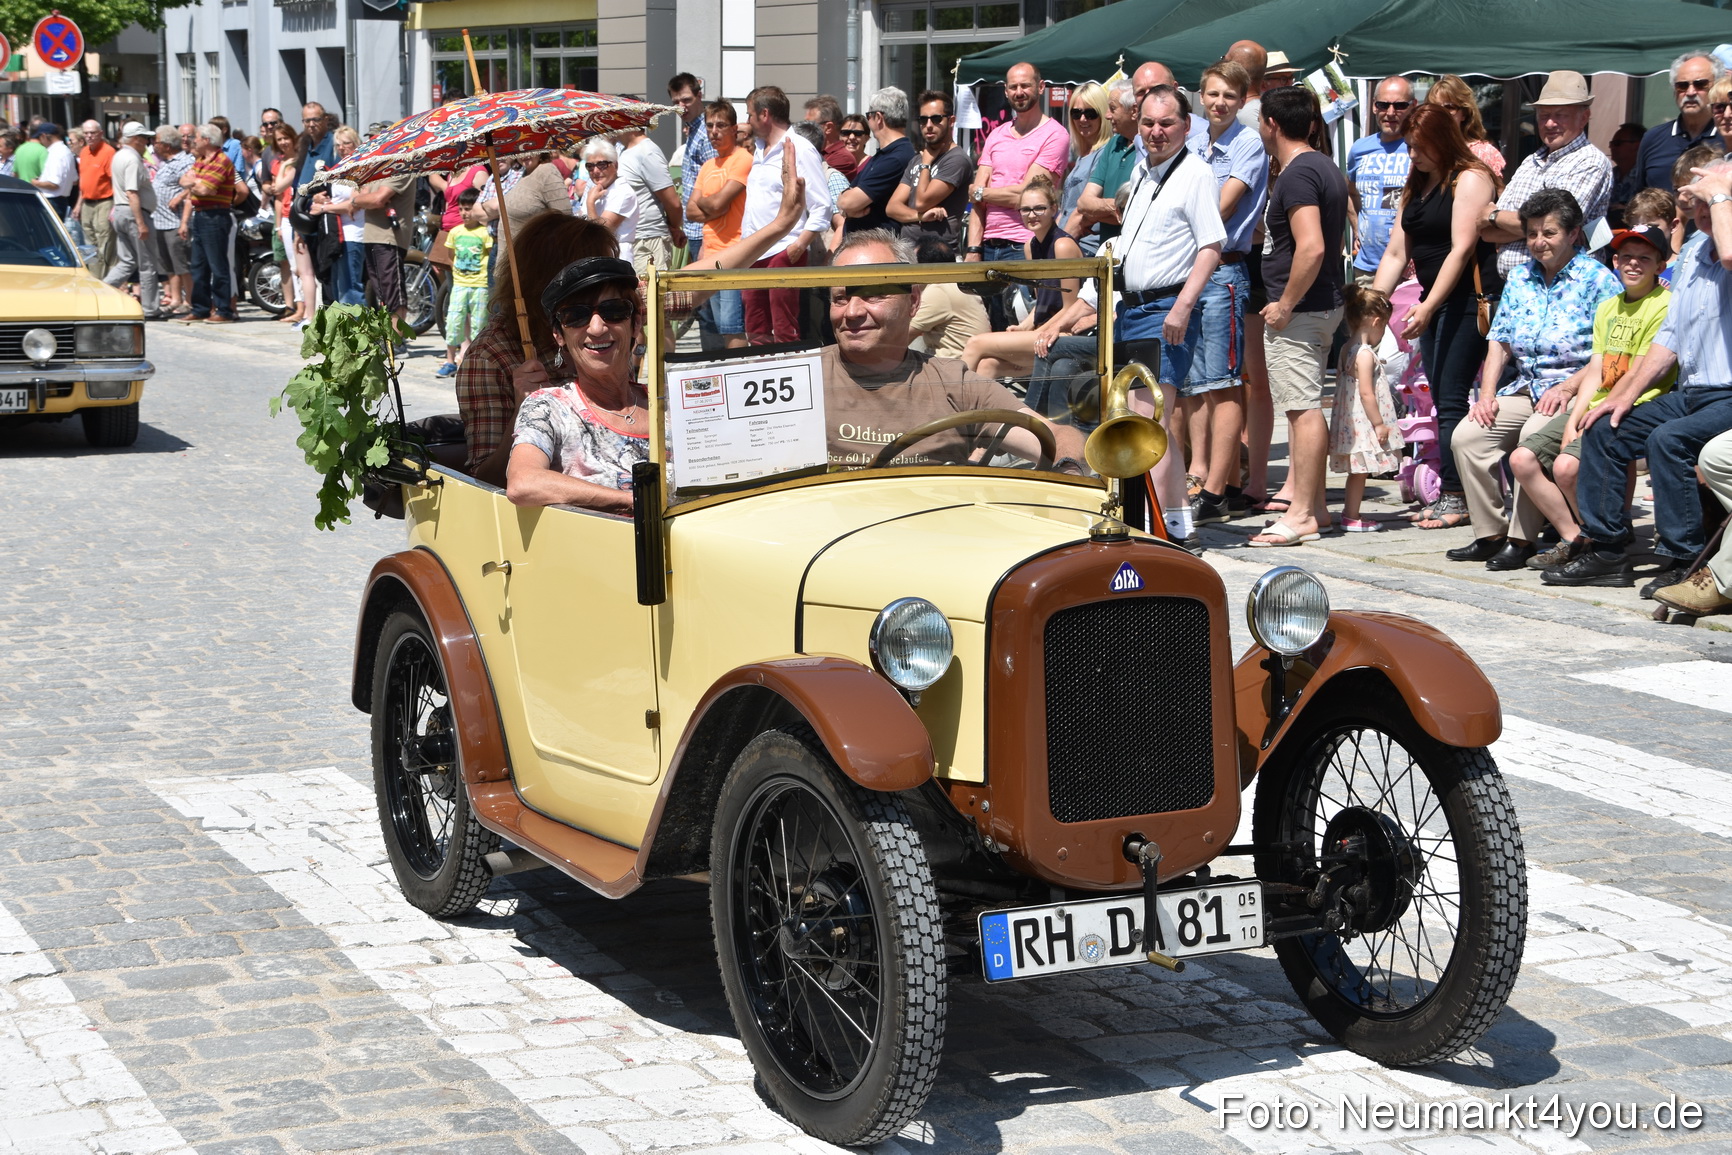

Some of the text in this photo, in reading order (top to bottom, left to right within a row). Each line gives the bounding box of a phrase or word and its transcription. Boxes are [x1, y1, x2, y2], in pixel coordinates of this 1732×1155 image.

[1610, 324, 1642, 341] CITY
[743, 376, 795, 407] 255
[845, 452, 859, 463] 60
[862, 452, 875, 464] Ja
[889, 453, 929, 466] gelaufen
[1113, 569, 1140, 590] DIXI
[1238, 891, 1257, 906] 05
[1012, 913, 1076, 969] RH
[1177, 895, 1231, 947] 81
[1240, 925, 1258, 940] 10
